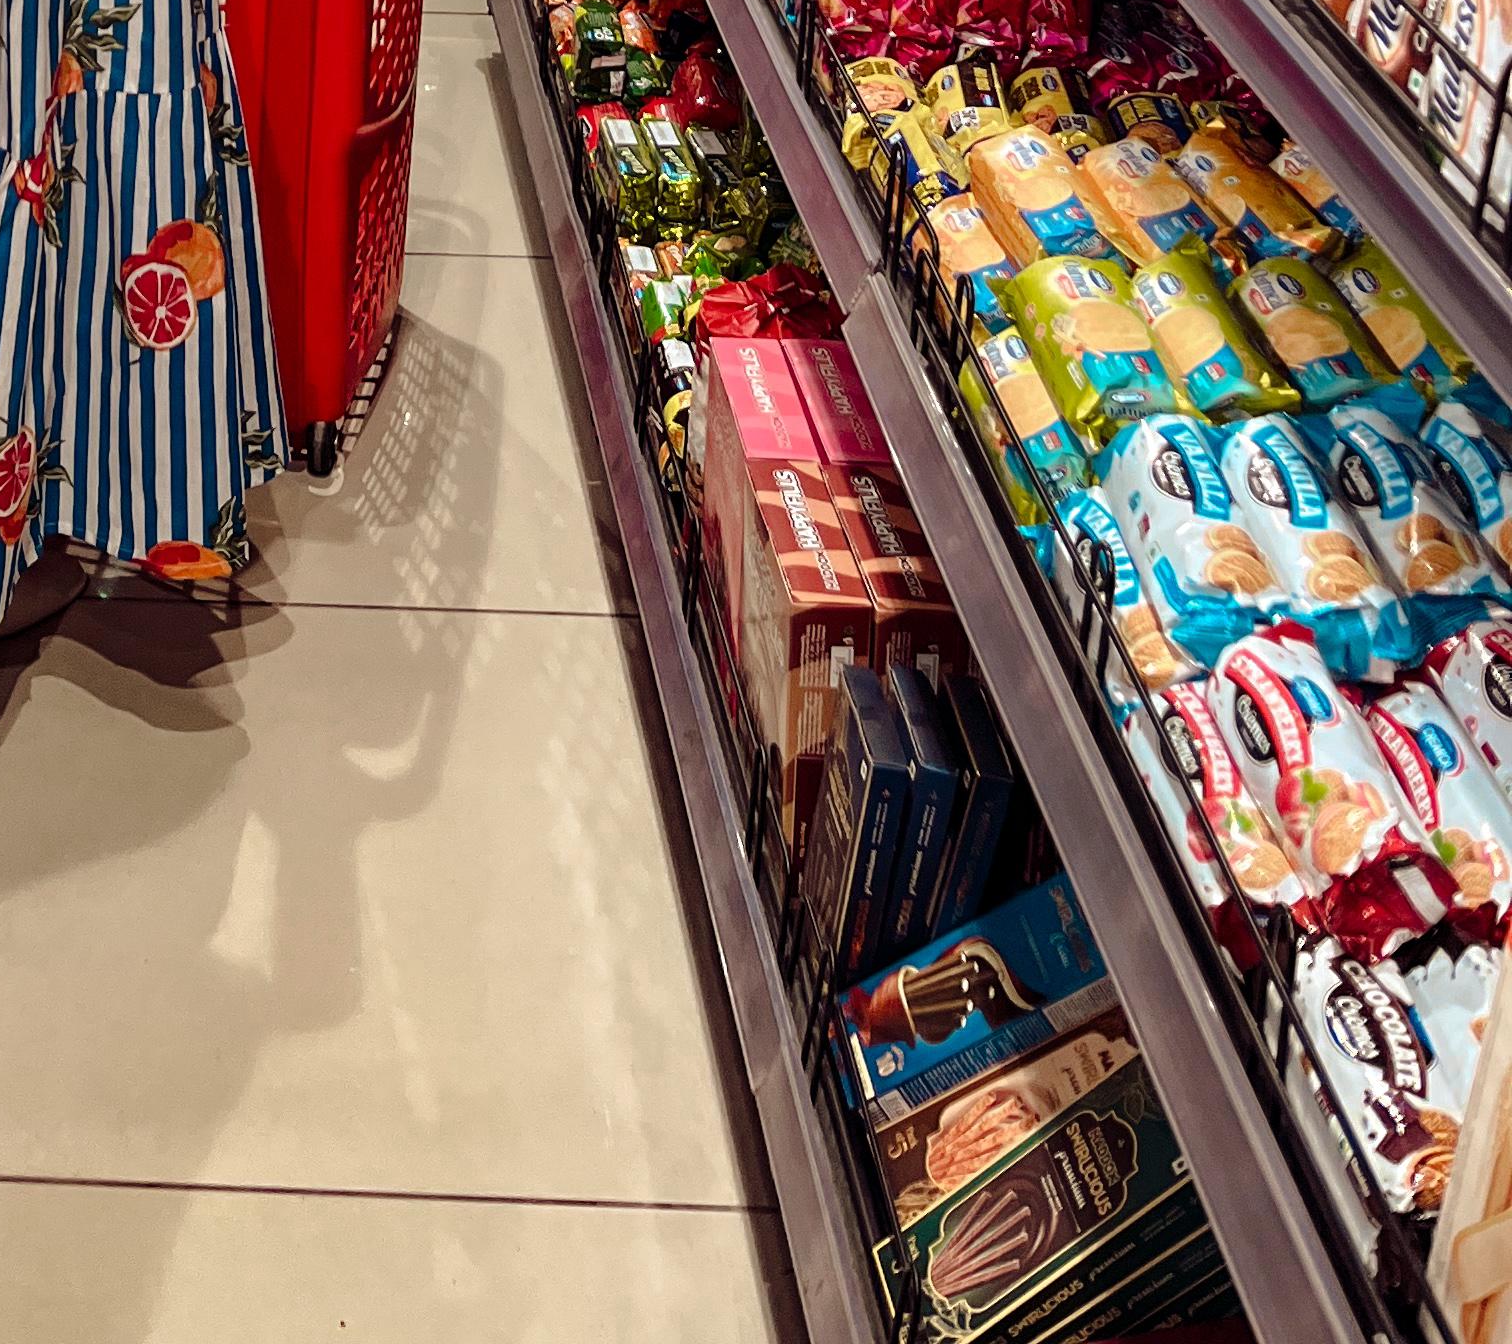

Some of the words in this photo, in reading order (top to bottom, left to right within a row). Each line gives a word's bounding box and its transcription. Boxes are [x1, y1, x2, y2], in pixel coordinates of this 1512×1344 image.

[1175, 428, 1230, 514] VANILLA
[1267, 433, 1323, 519] VANILLA
[1349, 423, 1408, 512] VANILLA
[1437, 425, 1500, 521] VANILLA
[1081, 502, 1134, 593] VANILLA
[1369, 712, 1437, 826] STRAWBERRY
[1338, 960, 1420, 1090] CHOCOLATE
[1065, 1121, 1113, 1219] SWIRLICIOUS
[1008, 1279, 1086, 1339] SWIRLICIOUS
